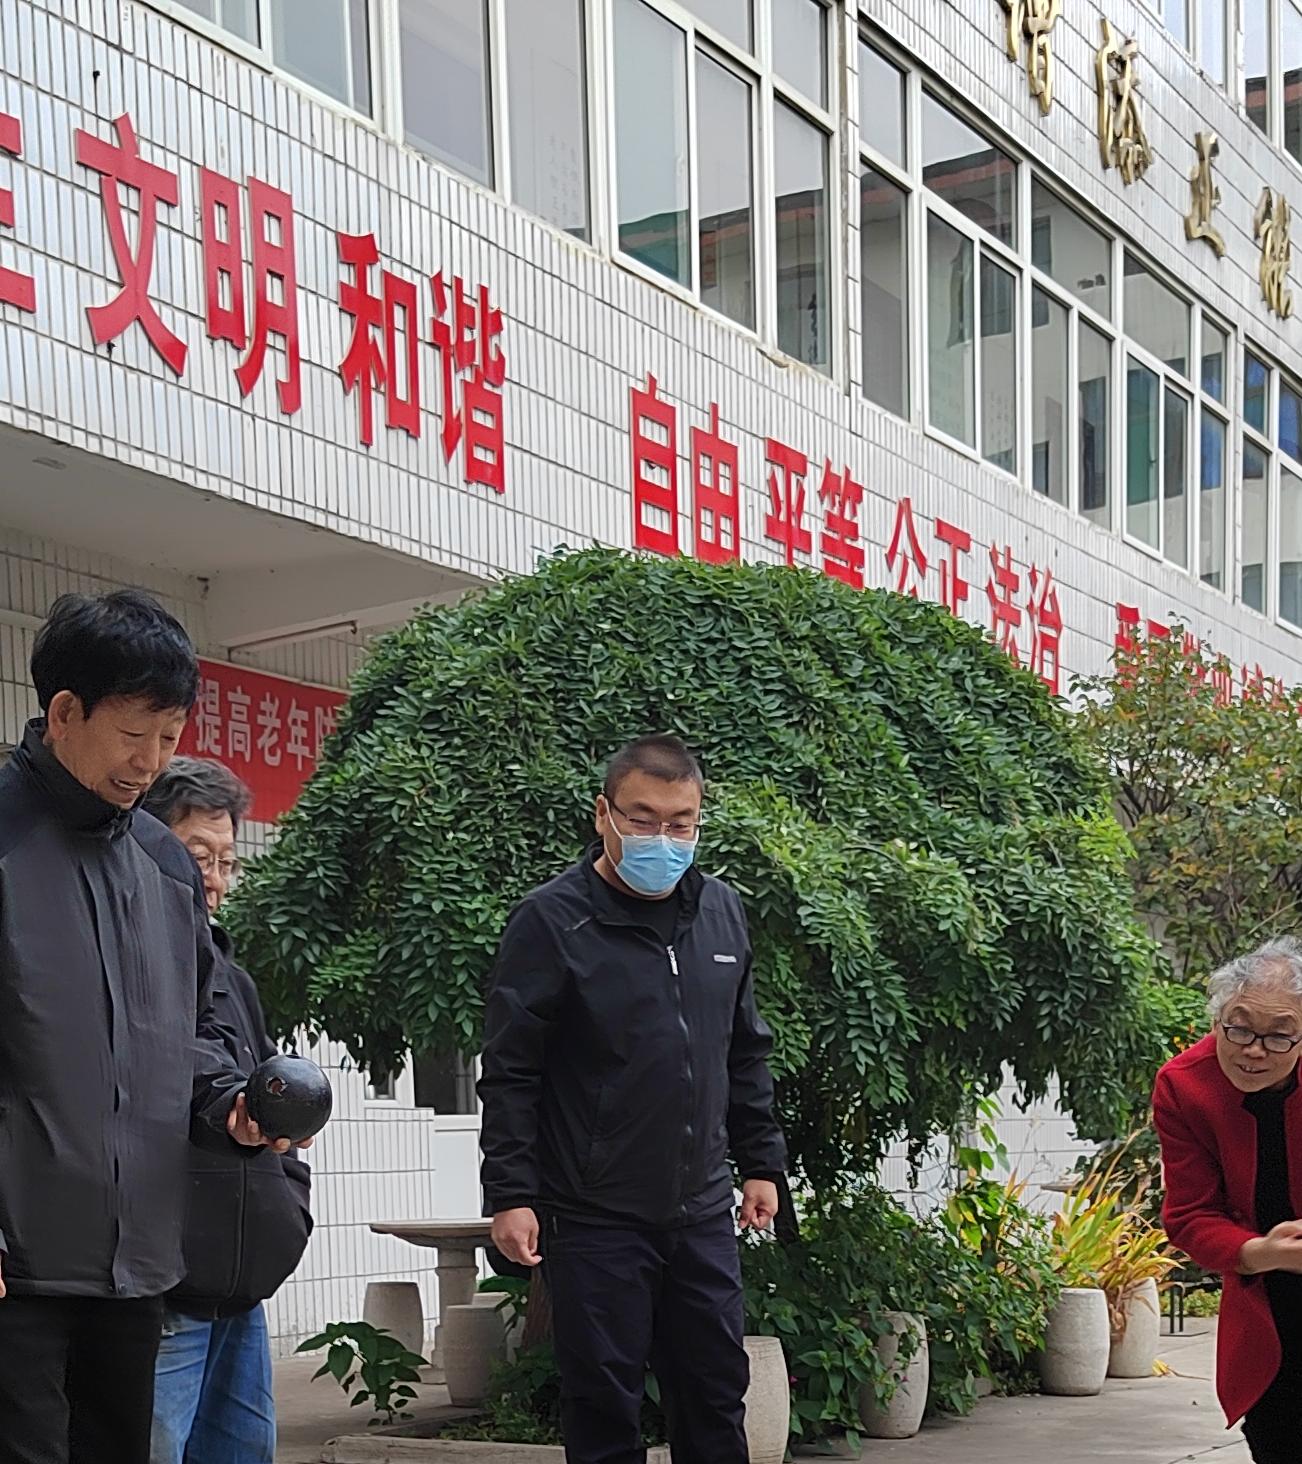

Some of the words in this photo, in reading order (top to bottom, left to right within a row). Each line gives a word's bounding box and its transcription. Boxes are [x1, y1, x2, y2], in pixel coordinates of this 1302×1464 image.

[630, 372, 1063, 696] 自由平等公正法治
